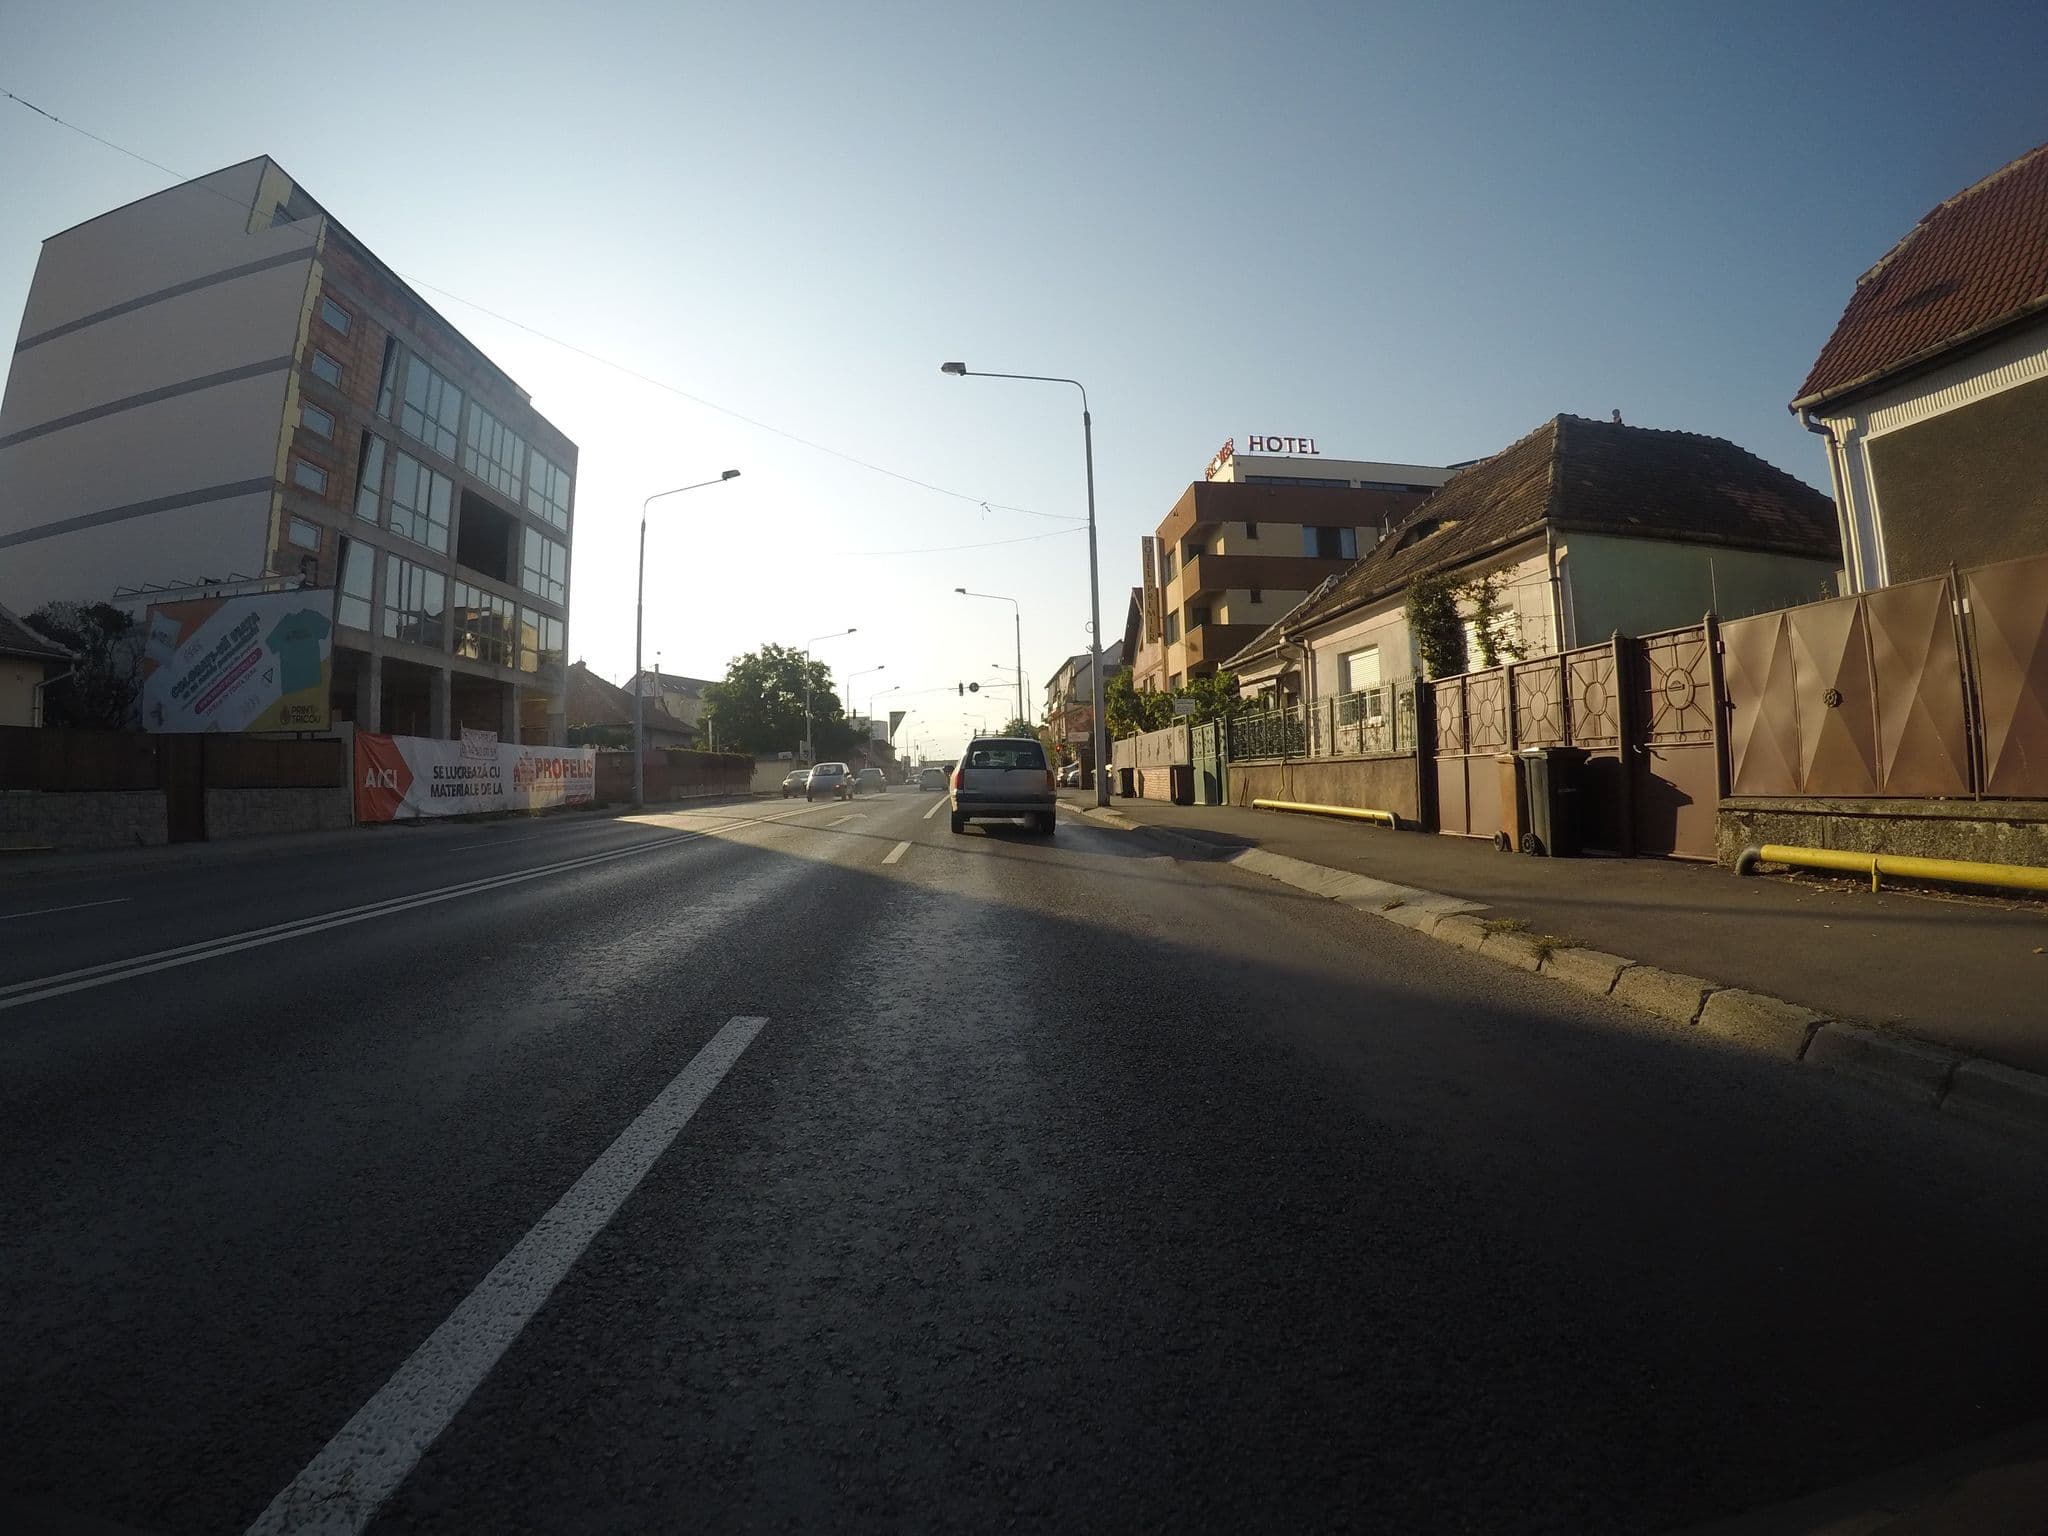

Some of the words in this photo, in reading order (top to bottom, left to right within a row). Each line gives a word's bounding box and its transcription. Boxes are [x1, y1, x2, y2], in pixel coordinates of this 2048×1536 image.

[1249, 435, 1320, 455] HOTEL
[1144, 538, 1152, 578] HOTEL
[1147, 584, 1156, 641] PREMIER
[433, 766, 444, 779] SE
[489, 765, 501, 778] CU
[535, 757, 593, 778] PROFELIS
[430, 783, 479, 798] MATERIALE
[481, 783, 492, 796] DE
[494, 783, 503, 795] LA
